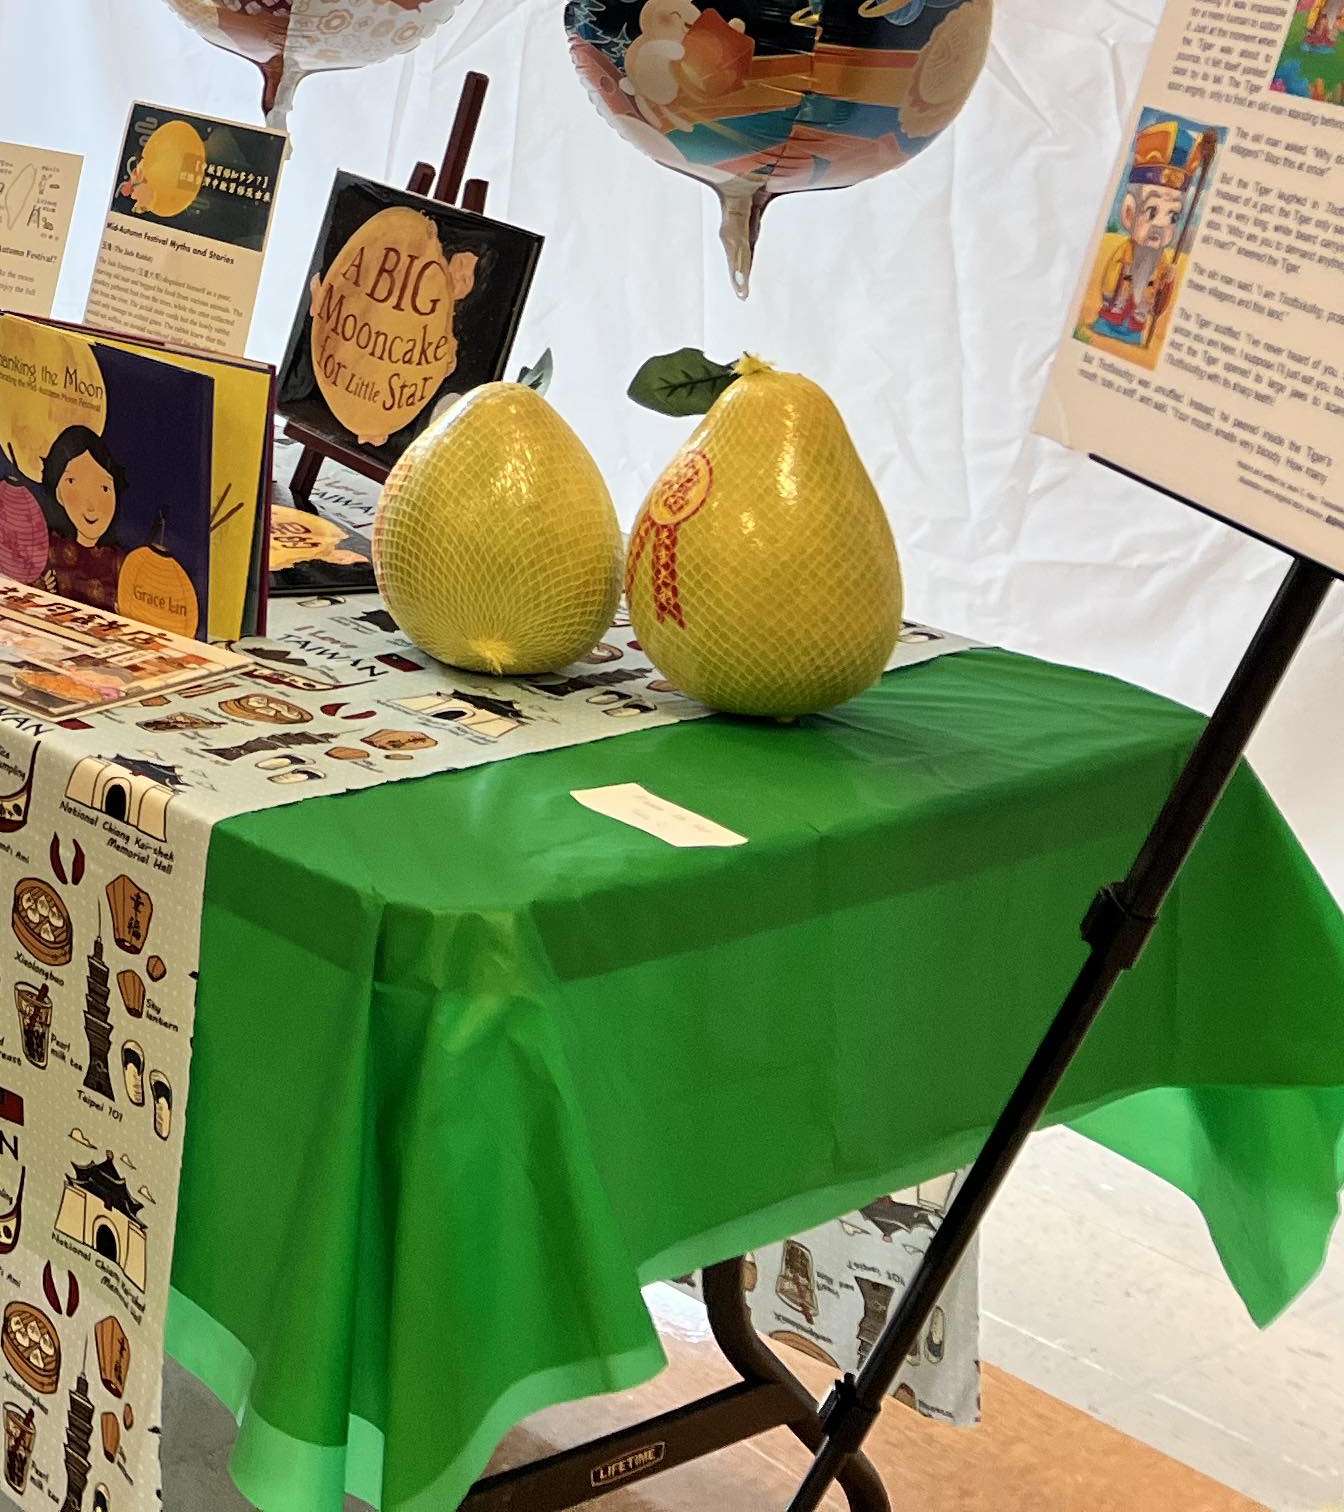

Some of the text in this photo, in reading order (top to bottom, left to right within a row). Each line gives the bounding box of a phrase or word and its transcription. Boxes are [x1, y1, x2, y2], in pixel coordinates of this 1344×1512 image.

[26, 249, 57, 263] Festival?
[107, 222, 234, 265] Mid-Autumn Festival Myths and Stories
[340, 246, 444, 317] A BIG
[318, 289, 449, 367] Mooncake
[41, 366, 58, 386] the
[64, 366, 103, 399] Moon
[319, 334, 433, 412] for Little Star
[133, 586, 187, 617] Grace Lin
[59, 800, 175, 862] National Chiang Kai-shek
[106, 837, 174, 875] Memorial Hall
[14, 950, 65, 987] Xiaolongbao
[145, 1011, 179, 1033] lantern
[146, 997, 161, 1016] Sky
[50, 1032, 71, 1053] Pearl
[50, 1047, 83, 1072] milk tea
[77, 1089, 123, 1122] Taipei 101
[52, 1231, 91, 1262] National
[600, 1448, 655, 1479] LIFETIME
